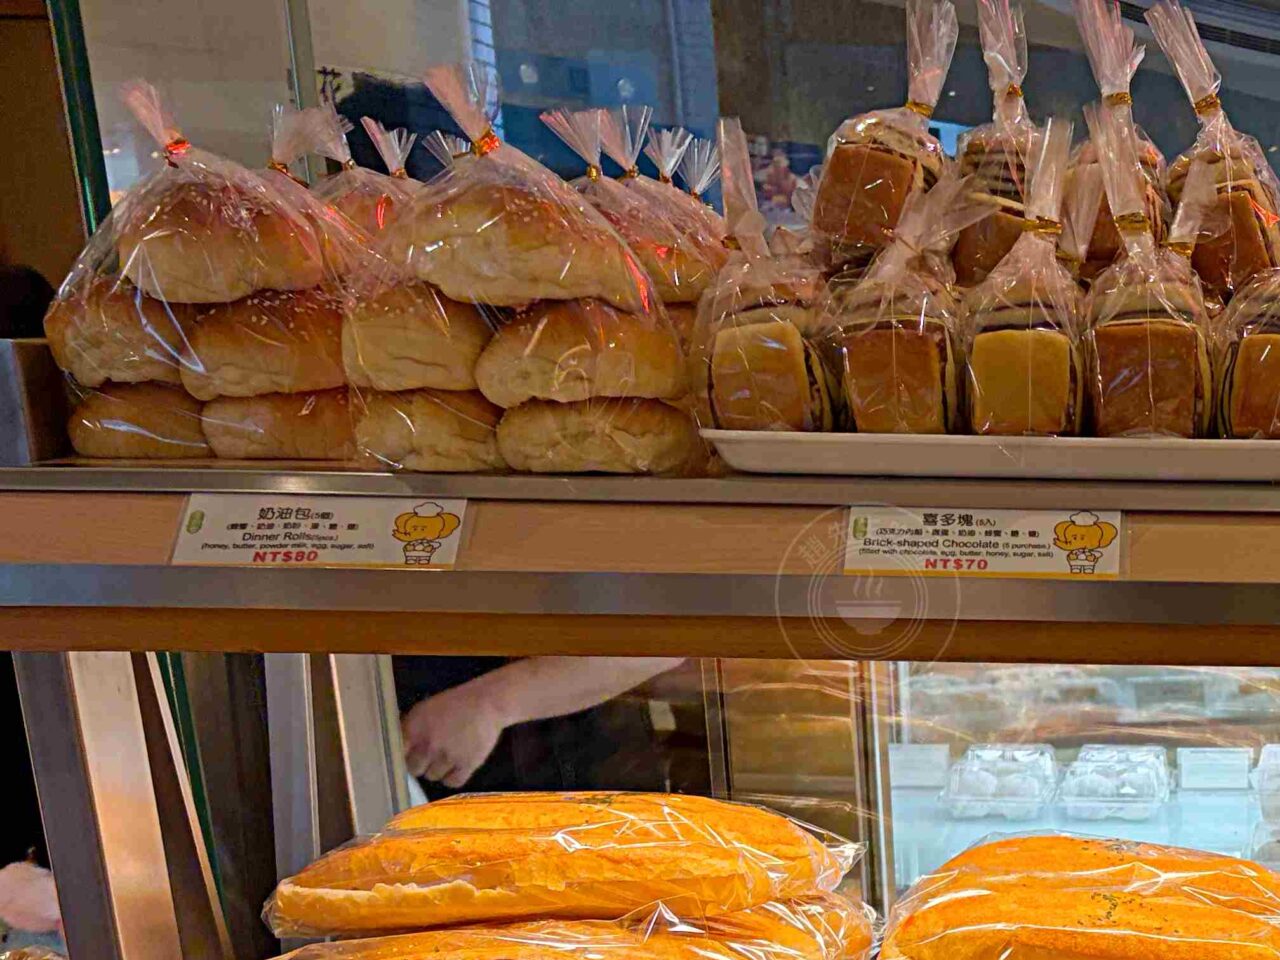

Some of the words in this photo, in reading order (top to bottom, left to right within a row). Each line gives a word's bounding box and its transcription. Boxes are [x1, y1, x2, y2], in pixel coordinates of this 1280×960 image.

[242, 532, 280, 541] Dinner
[863, 538, 939, 548] Brick-shaped
[942, 539, 1000, 549] Chocolate
[253, 551, 318, 562] NT$80
[925, 558, 988, 570] NT$70
